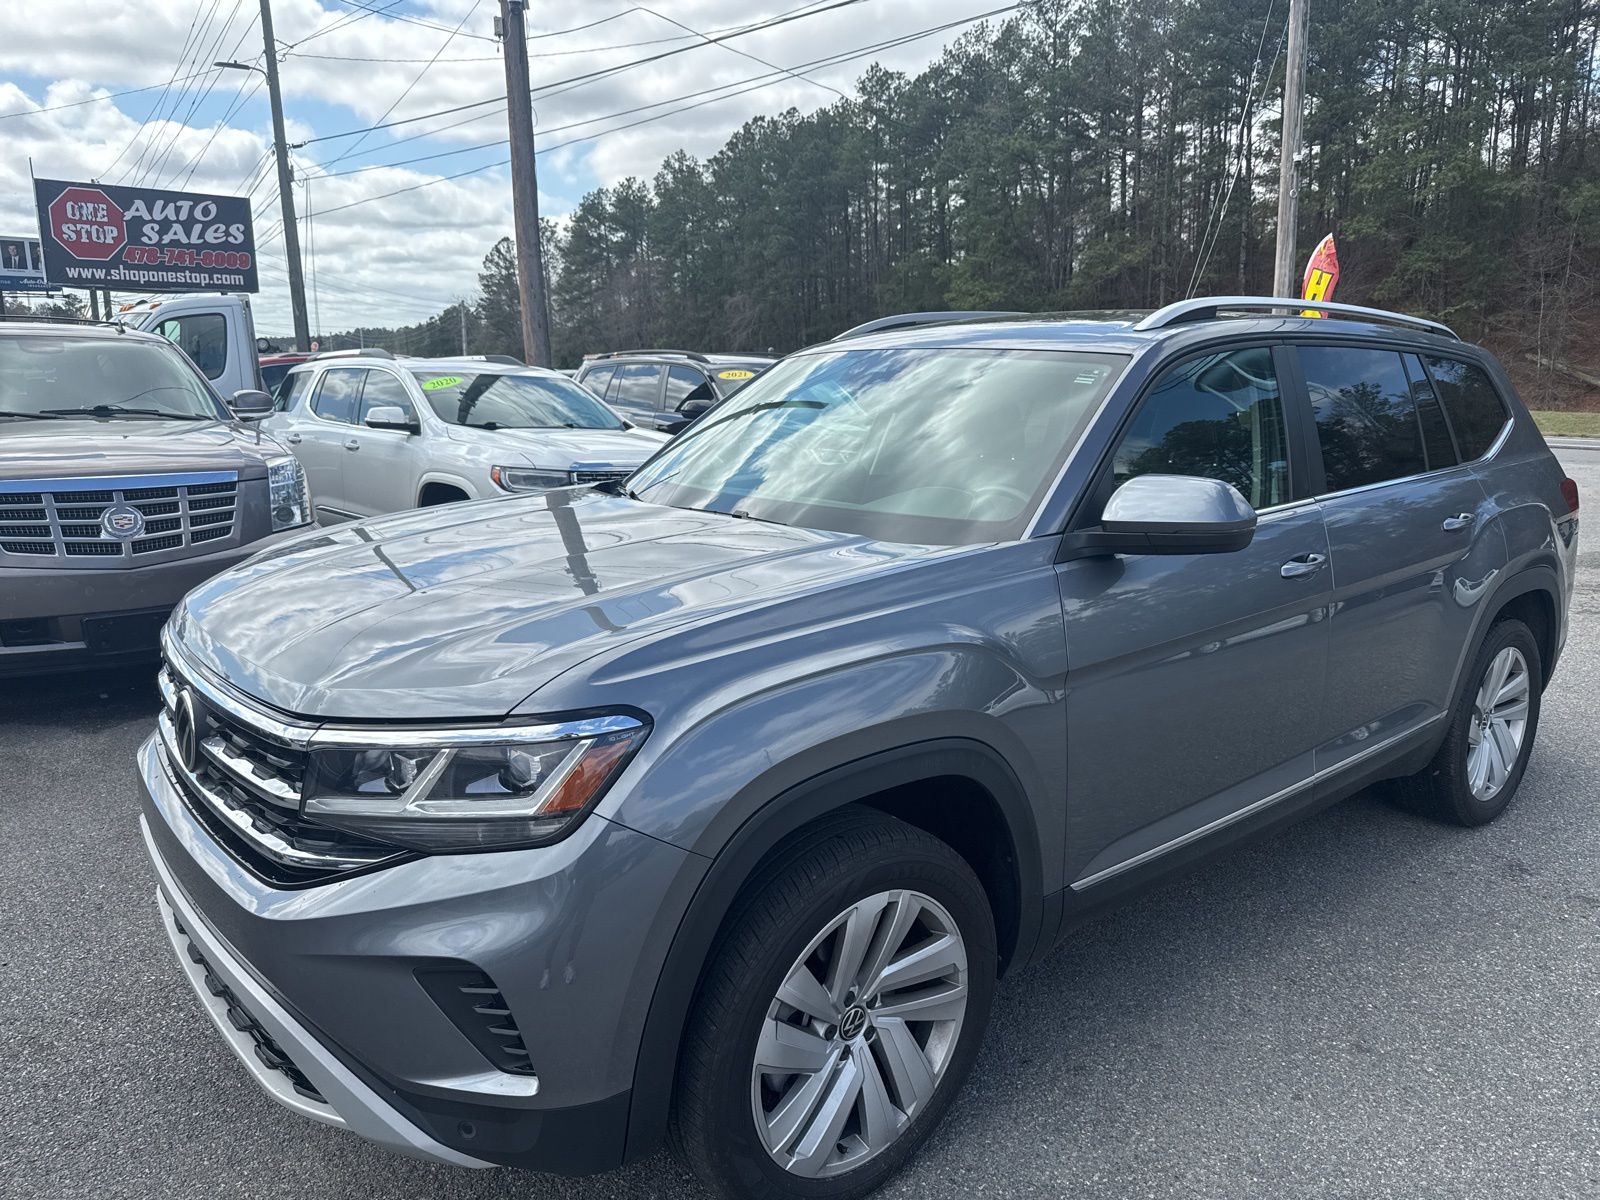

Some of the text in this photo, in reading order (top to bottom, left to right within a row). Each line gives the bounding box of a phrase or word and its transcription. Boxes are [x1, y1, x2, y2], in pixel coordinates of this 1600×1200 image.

[66, 201, 108, 222] ONE
[123, 199, 217, 221] AUTO
[61, 223, 118, 244] STOP
[122, 245, 251, 270] 478-741-8009
[66, 265, 244, 286] www.shoponestop.com
[430, 377, 457, 389] 2020
